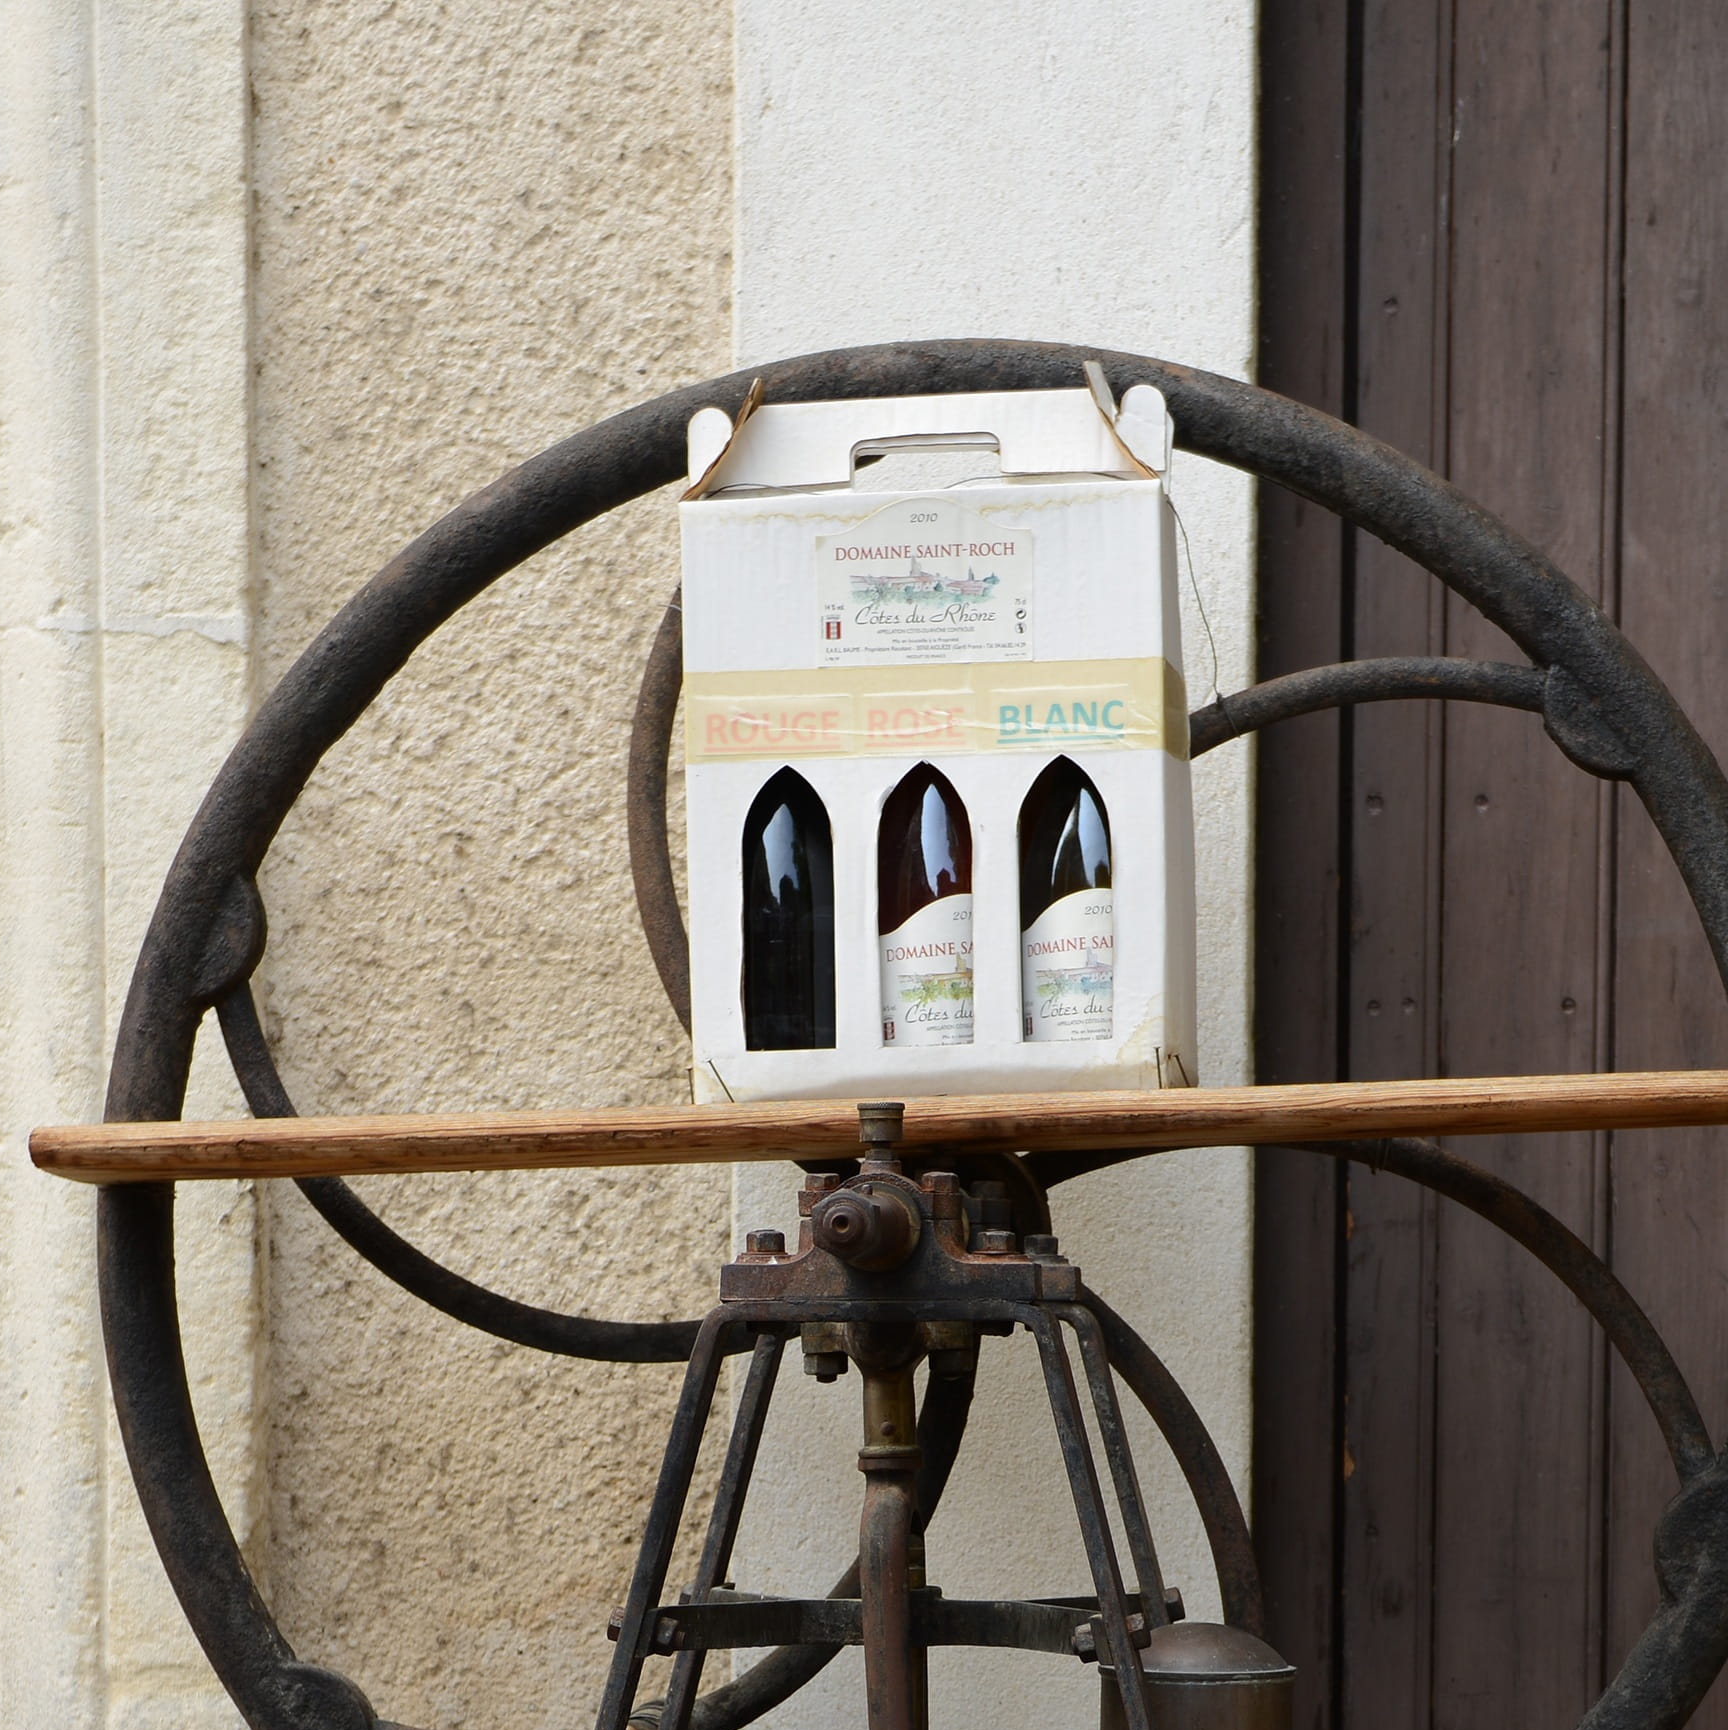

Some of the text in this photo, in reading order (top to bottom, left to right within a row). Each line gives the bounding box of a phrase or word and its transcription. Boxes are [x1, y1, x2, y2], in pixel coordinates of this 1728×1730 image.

[910, 513, 938, 523] 2010
[835, 542, 1015, 561] DOMAINE SAINT-ROCH
[855, 602, 997, 625] Côtes du Rhône
[705, 711, 841, 746] ROUGE
[998, 700, 1125, 737] BLANC
[1084, 905, 1112, 915] 2010
[886, 942, 956, 962] DOMAINE
[1027, 937, 1086, 957] DOMAINE
[905, 1001, 949, 1023] Côtes
[1040, 994, 1103, 1019] Côtes du
